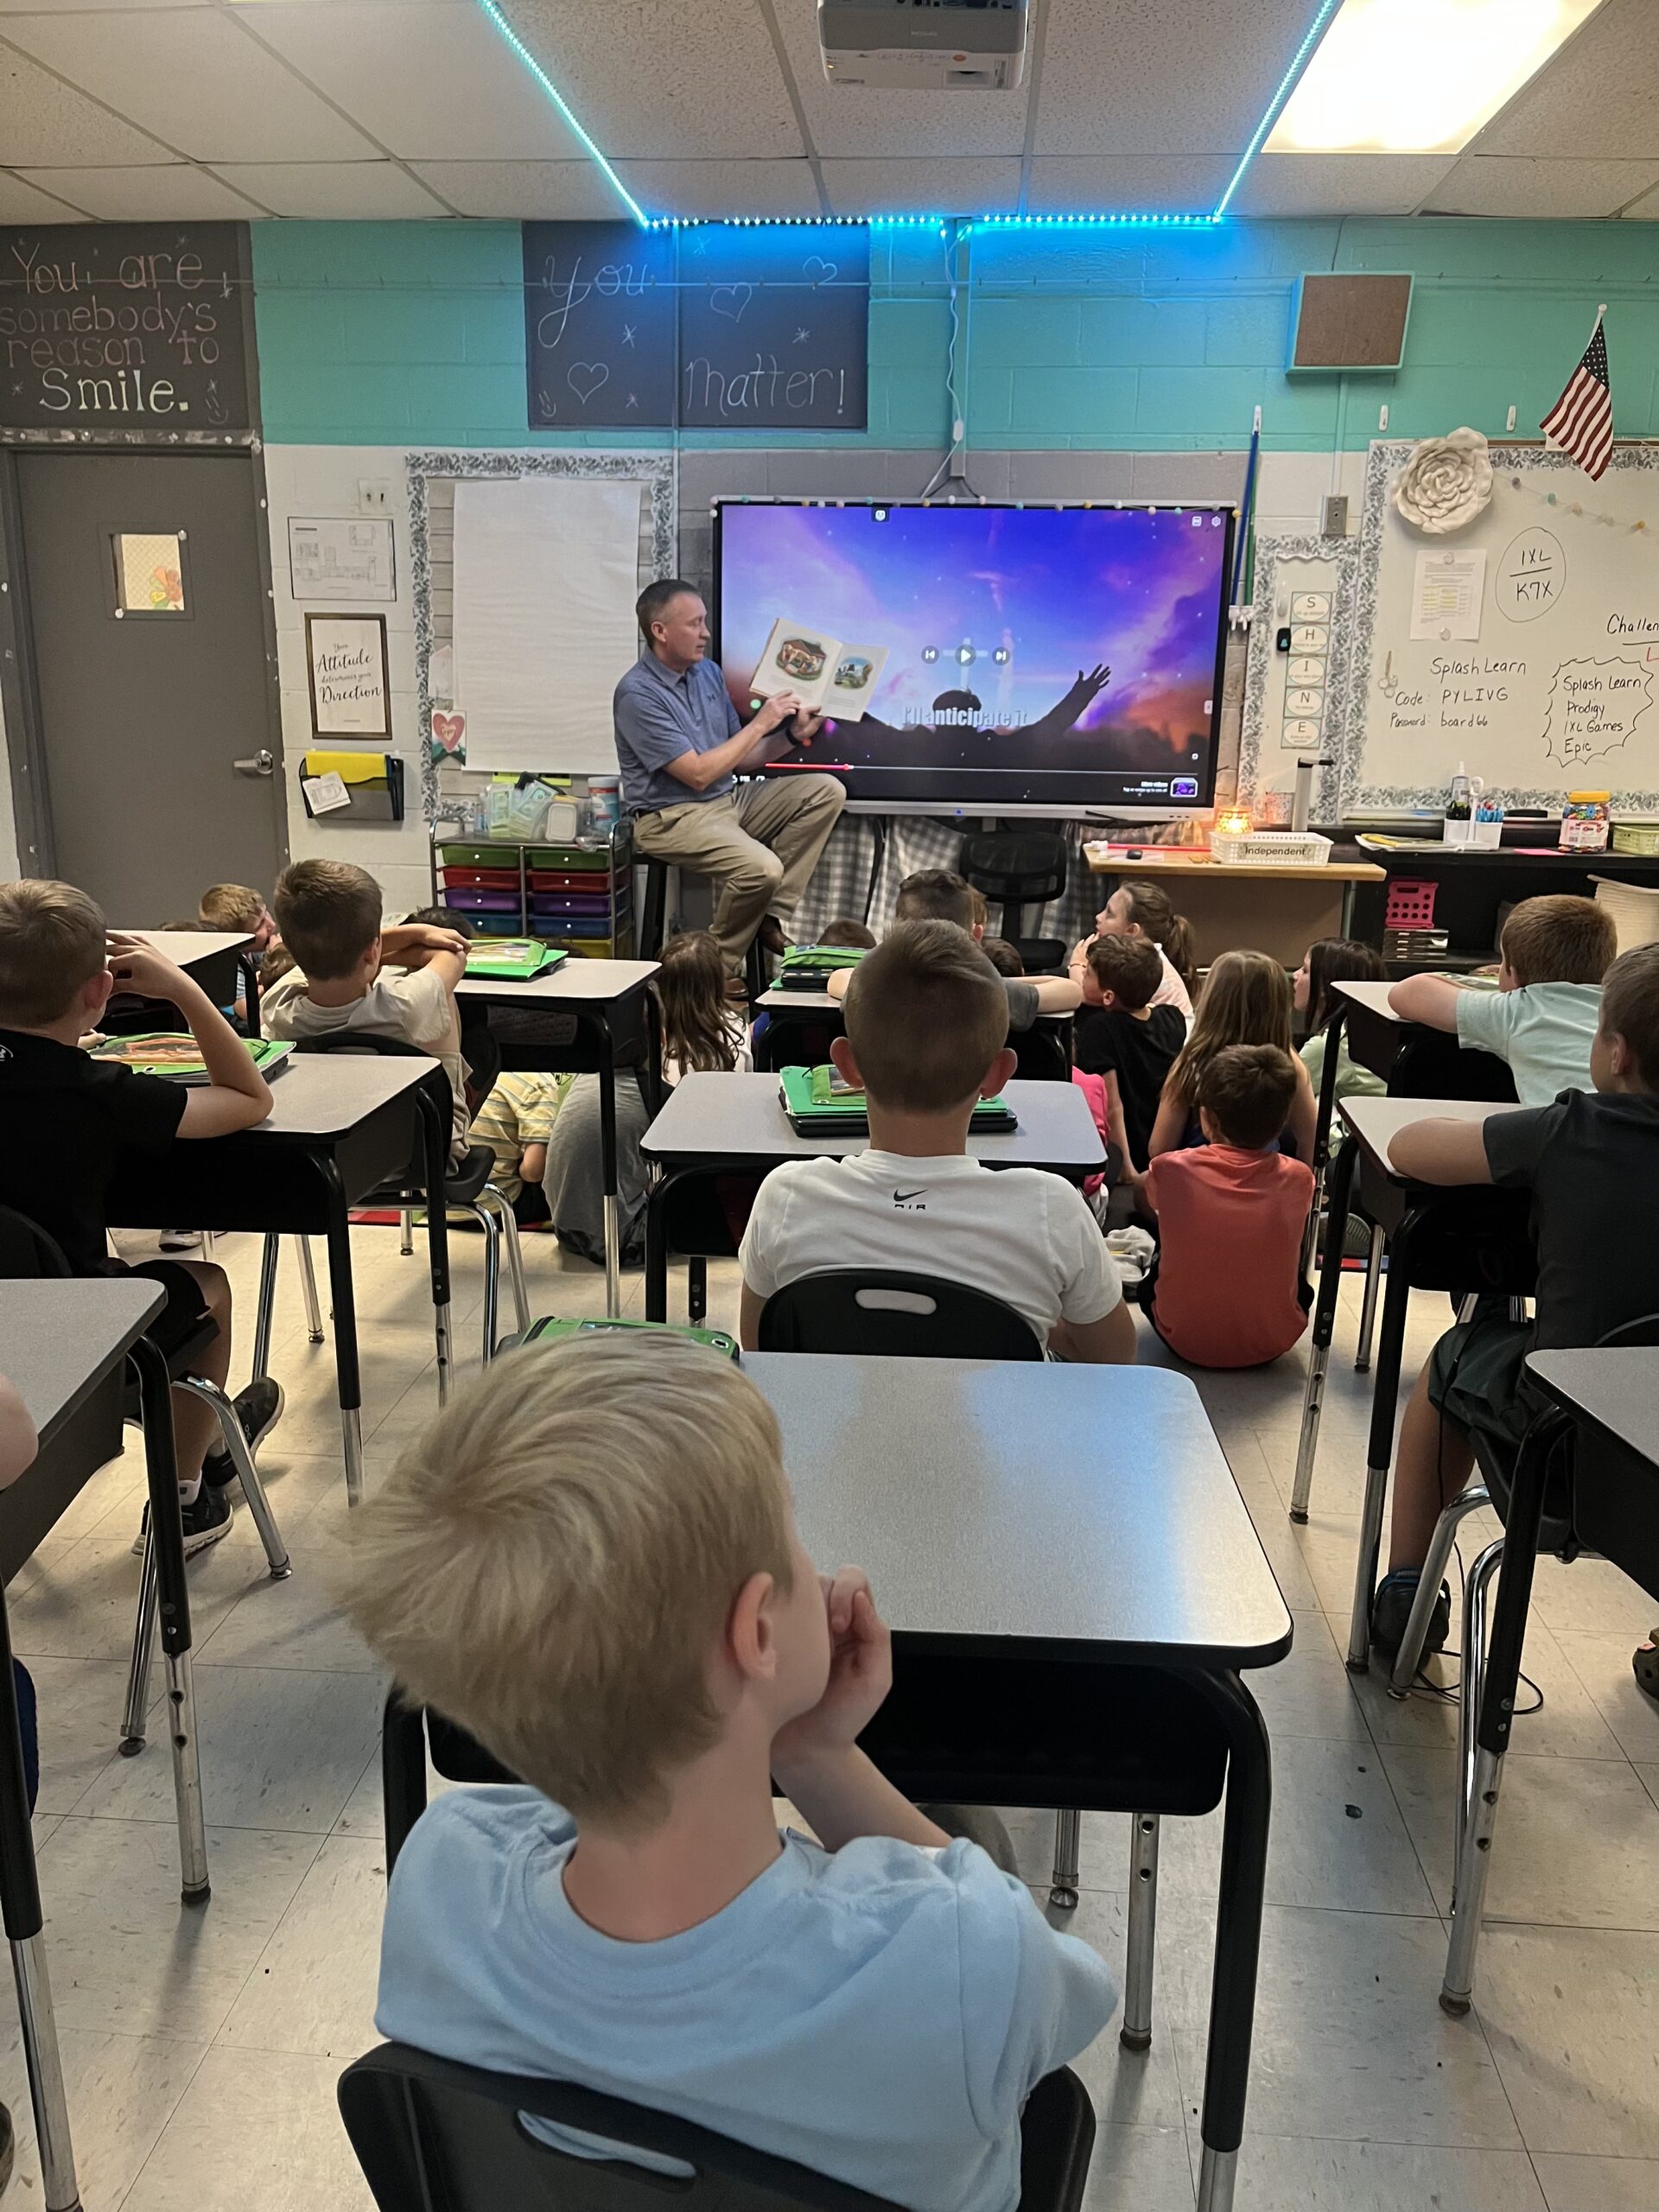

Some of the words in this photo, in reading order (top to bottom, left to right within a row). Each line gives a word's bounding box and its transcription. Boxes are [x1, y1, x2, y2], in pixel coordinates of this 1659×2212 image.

[10, 243, 79, 294] You
[119, 253, 203, 289] are
[0, 291, 217, 343] somebody's
[7, 336, 146, 368] reason
[176, 330, 220, 365] to
[39, 367, 189, 413] Smile.
[1516, 580, 1553, 601] K7X
[315, 648, 373, 673] Attitude
[1430, 657, 1479, 683] Splash
[1484, 657, 1527, 676] Learn
[319, 685, 382, 704] Direction
[1563, 676, 1603, 697] Splash
[1608, 676, 1642, 690] Learn
[925, 707, 1013, 728] anticipate
[1567, 698, 1605, 721] Prodigy
[1586, 719, 1624, 734] Games
[1564, 737, 1592, 759] Epic
[1244, 846, 1306, 856] Independent
